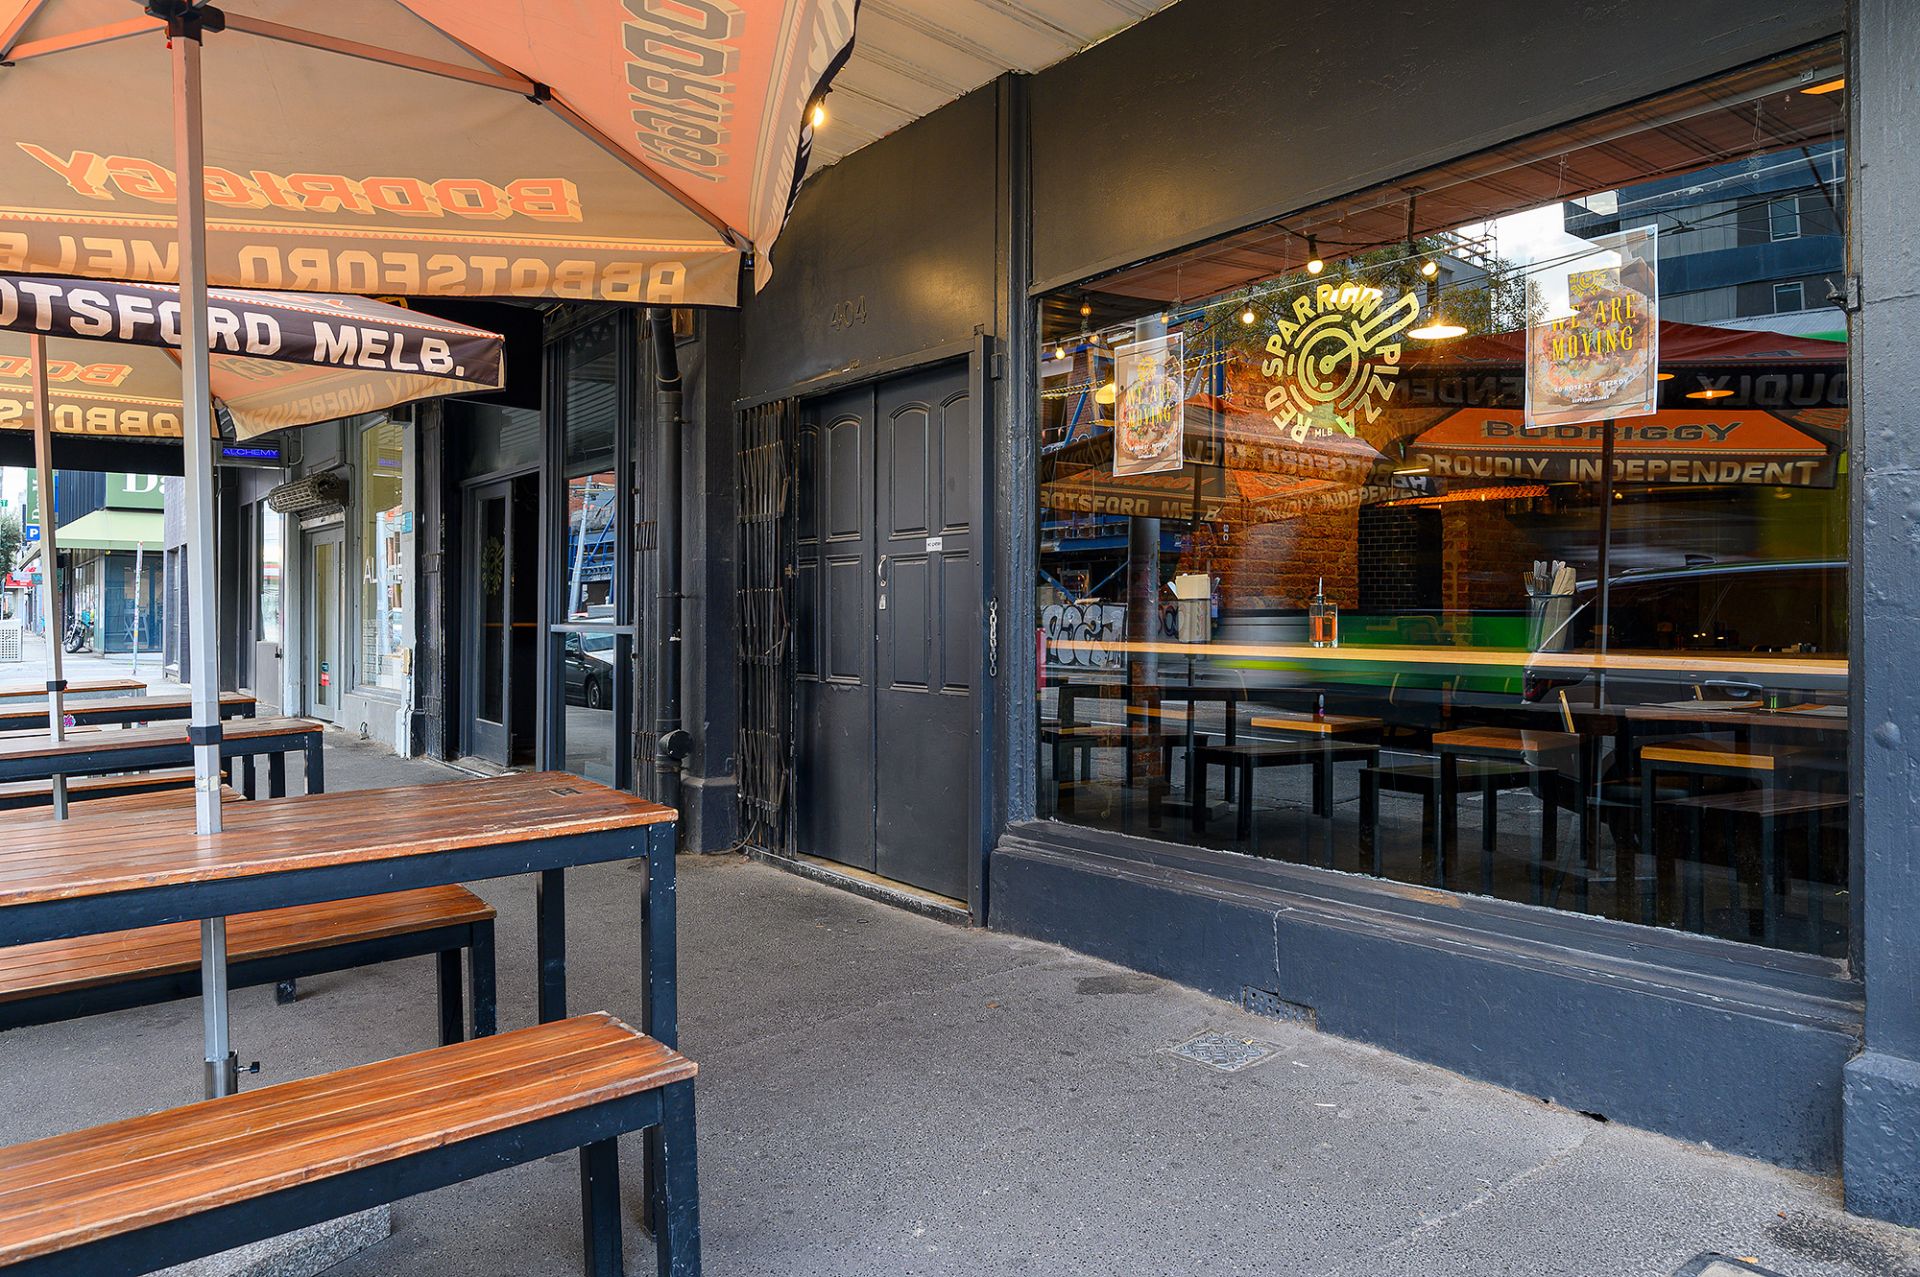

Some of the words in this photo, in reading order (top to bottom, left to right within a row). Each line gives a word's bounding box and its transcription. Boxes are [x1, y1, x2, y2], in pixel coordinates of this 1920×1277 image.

[830, 295, 868, 332] 404
[1594, 294, 1637, 325] ARE
[1262, 282, 1383, 378] SPARROW
[1552, 325, 1633, 362] MOVING
[312, 321, 465, 377] MELB.
[1336, 343, 1401, 438] PIZZA
[1265, 385, 1312, 444] RED
[1314, 427, 1333, 438] MLB
[223, 448, 278, 456] ALCHEMY
[1415, 453, 1549, 479] PROUDLY
[1570, 458, 1820, 485] INDEPENDENT
[30, 529, 39, 538] P
